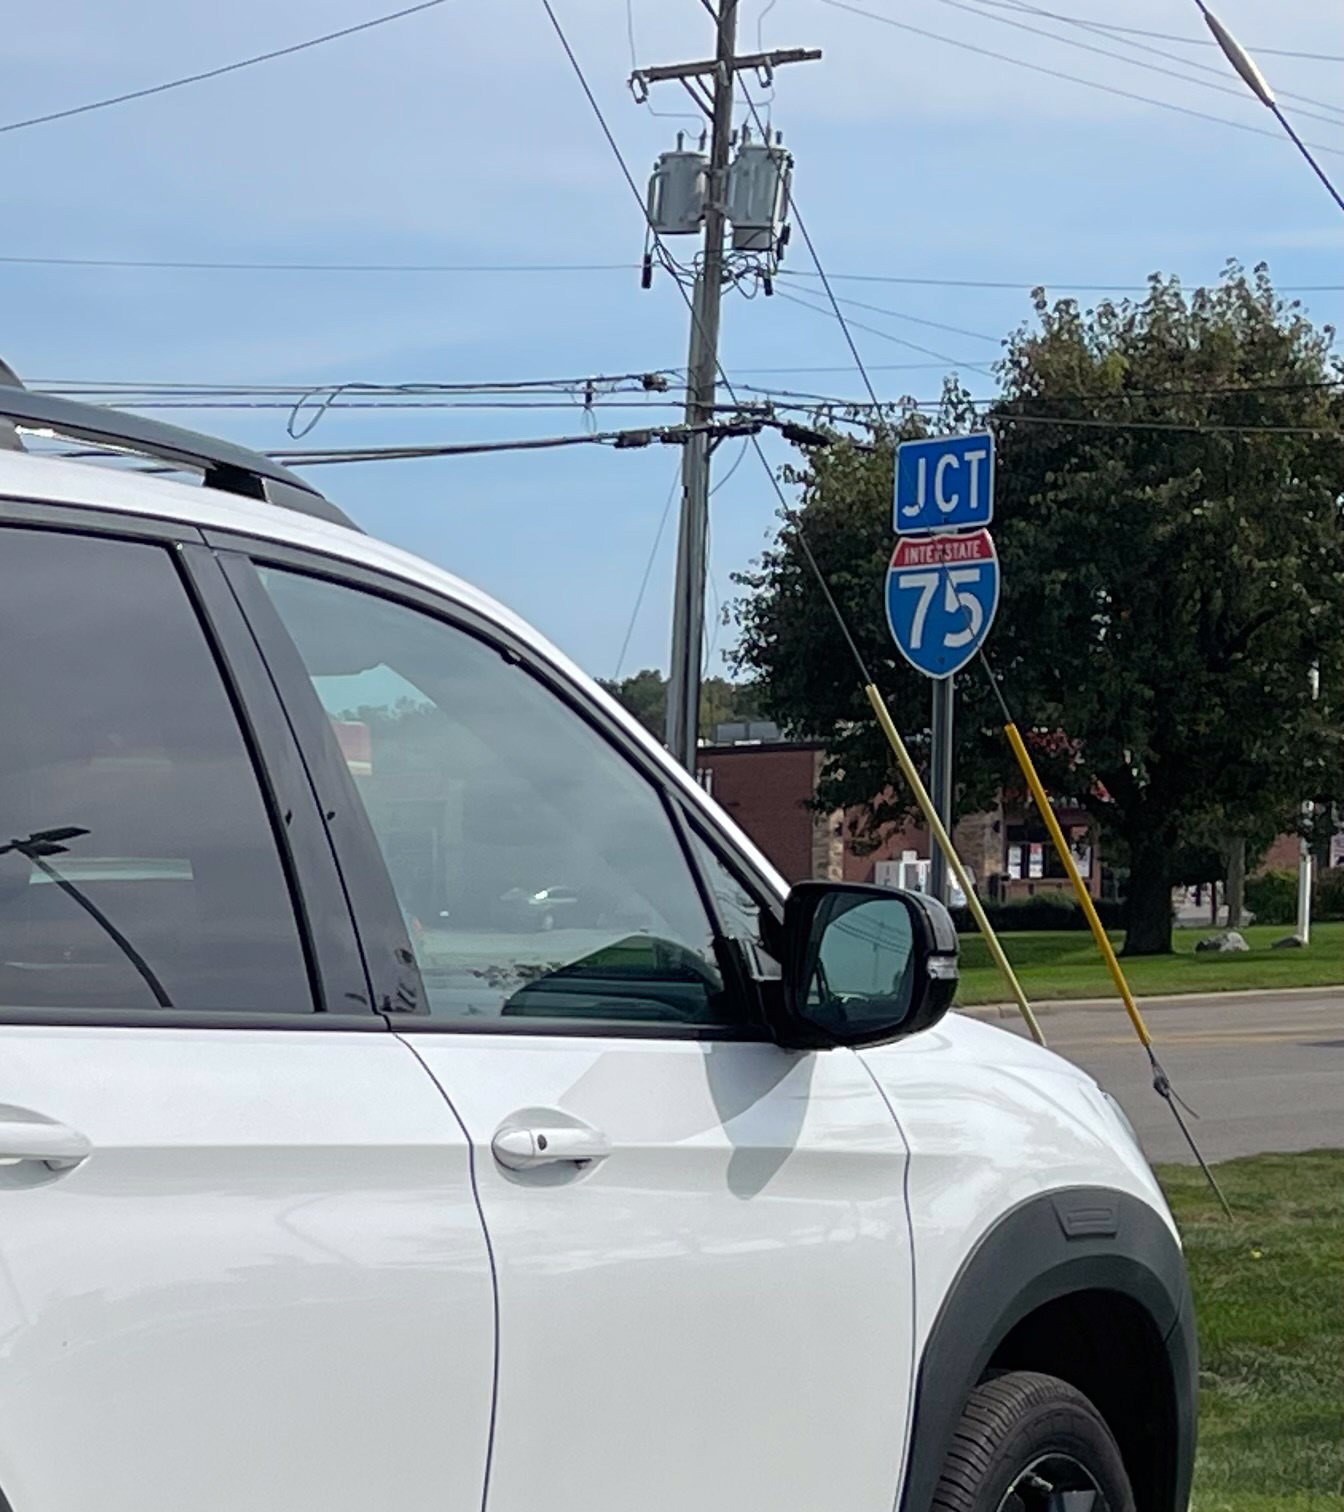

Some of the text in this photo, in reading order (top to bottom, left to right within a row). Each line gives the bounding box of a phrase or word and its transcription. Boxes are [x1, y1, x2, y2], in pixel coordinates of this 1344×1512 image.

[901, 449, 987, 517] JCT
[903, 539, 982, 565] INTERSTATE
[898, 568, 984, 649] 75
